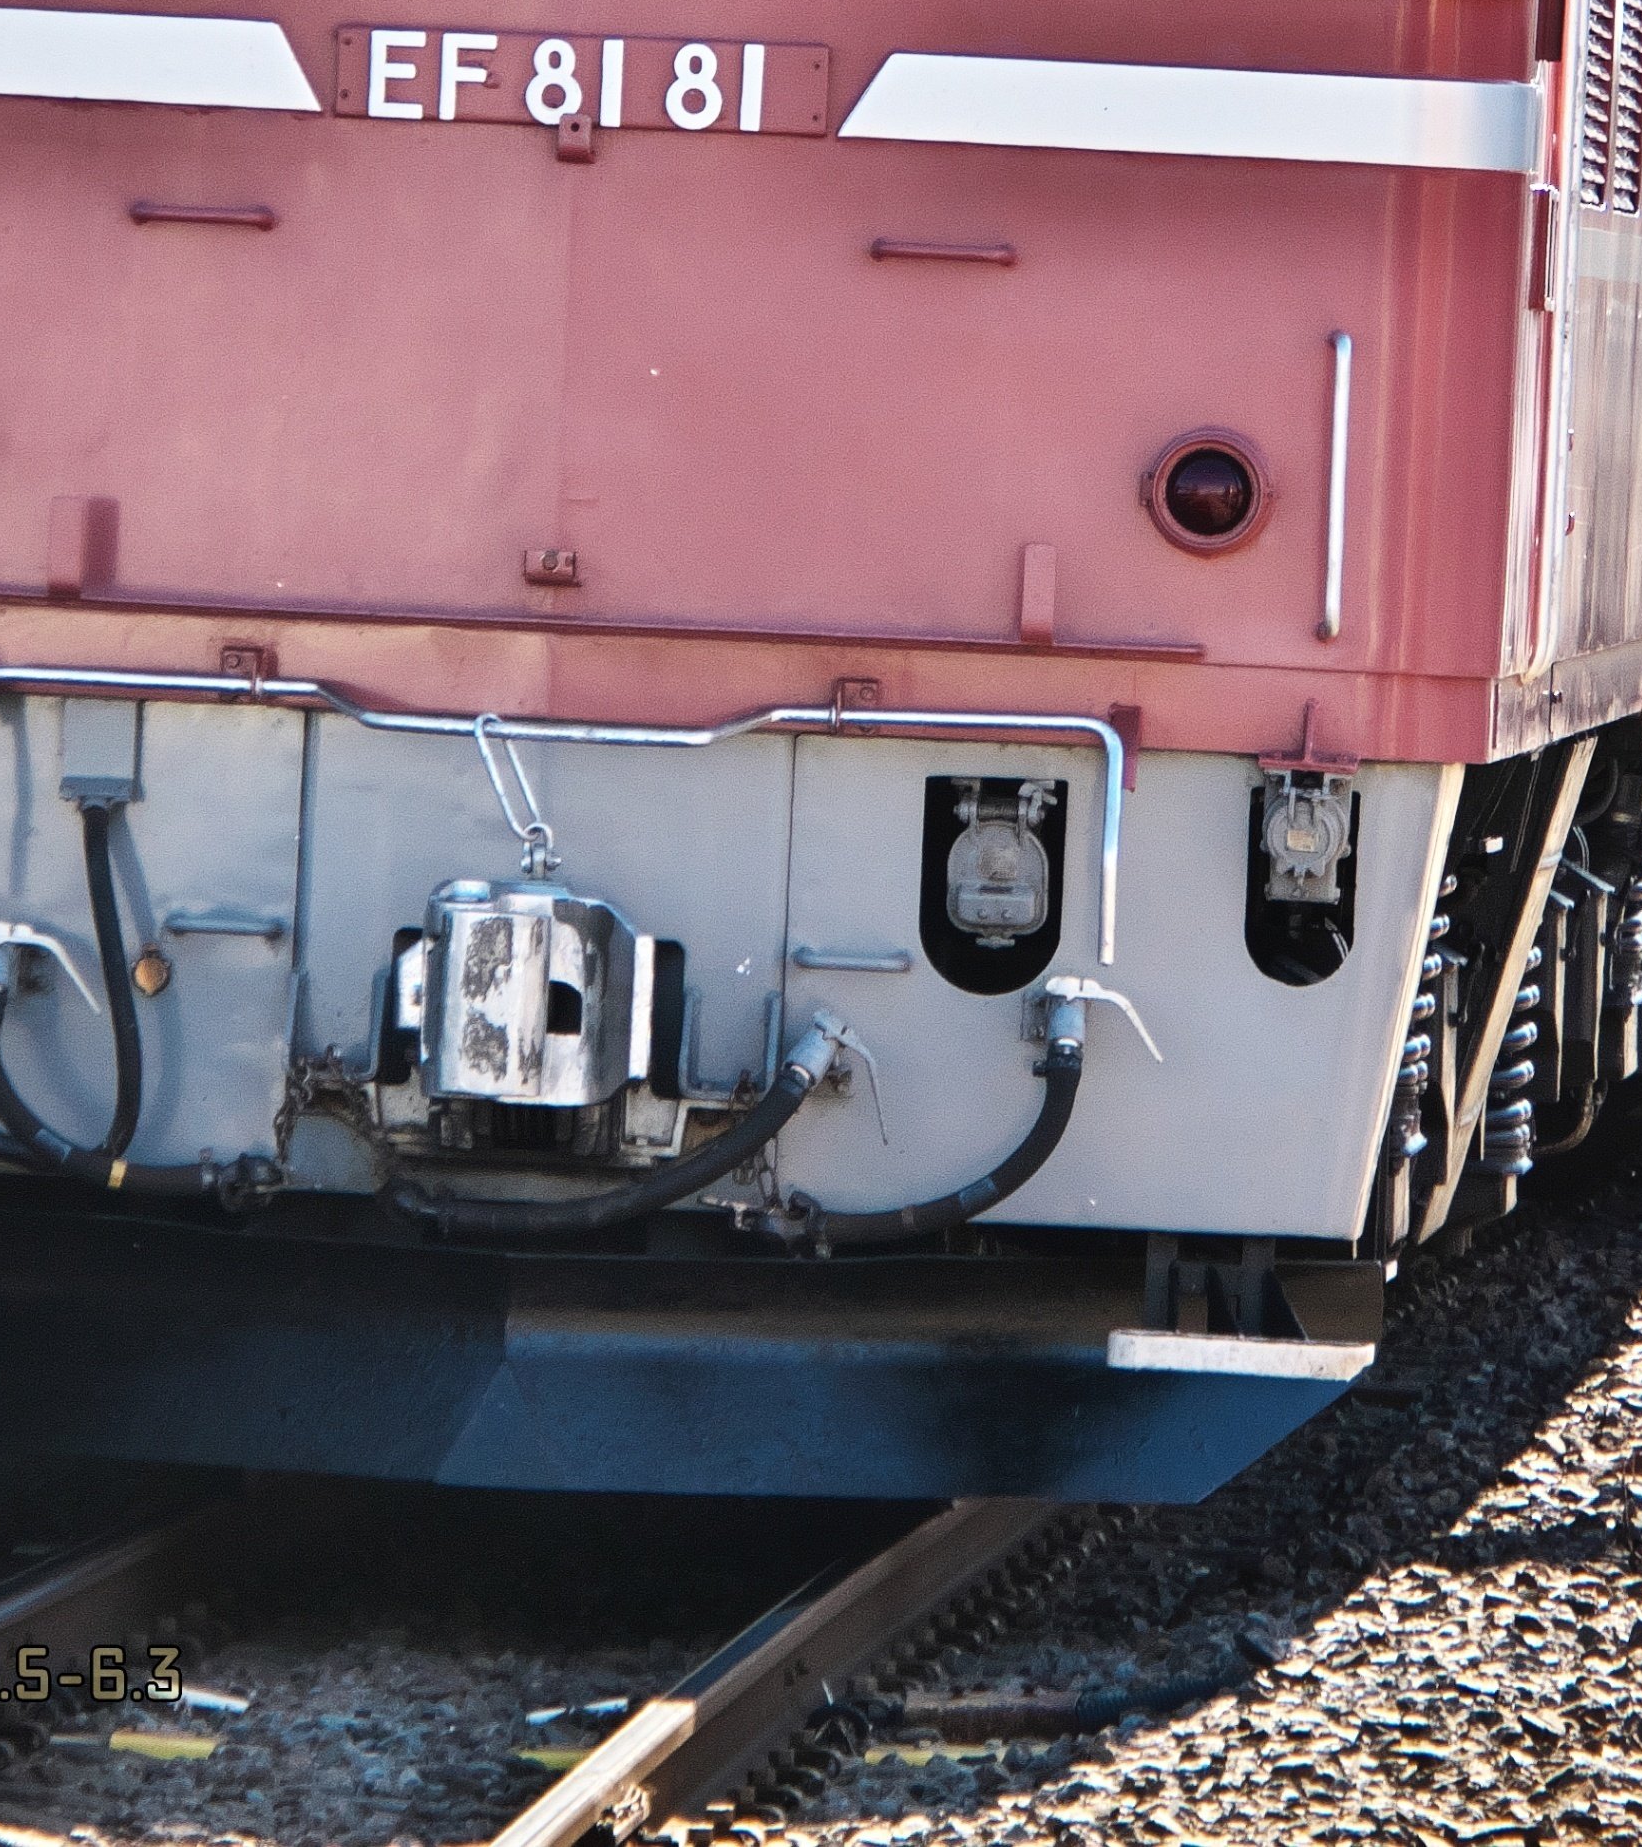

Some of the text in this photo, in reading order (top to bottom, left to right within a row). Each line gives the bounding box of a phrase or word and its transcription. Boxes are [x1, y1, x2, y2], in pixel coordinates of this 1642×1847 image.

[366, 29, 766, 131] EF 81 81
